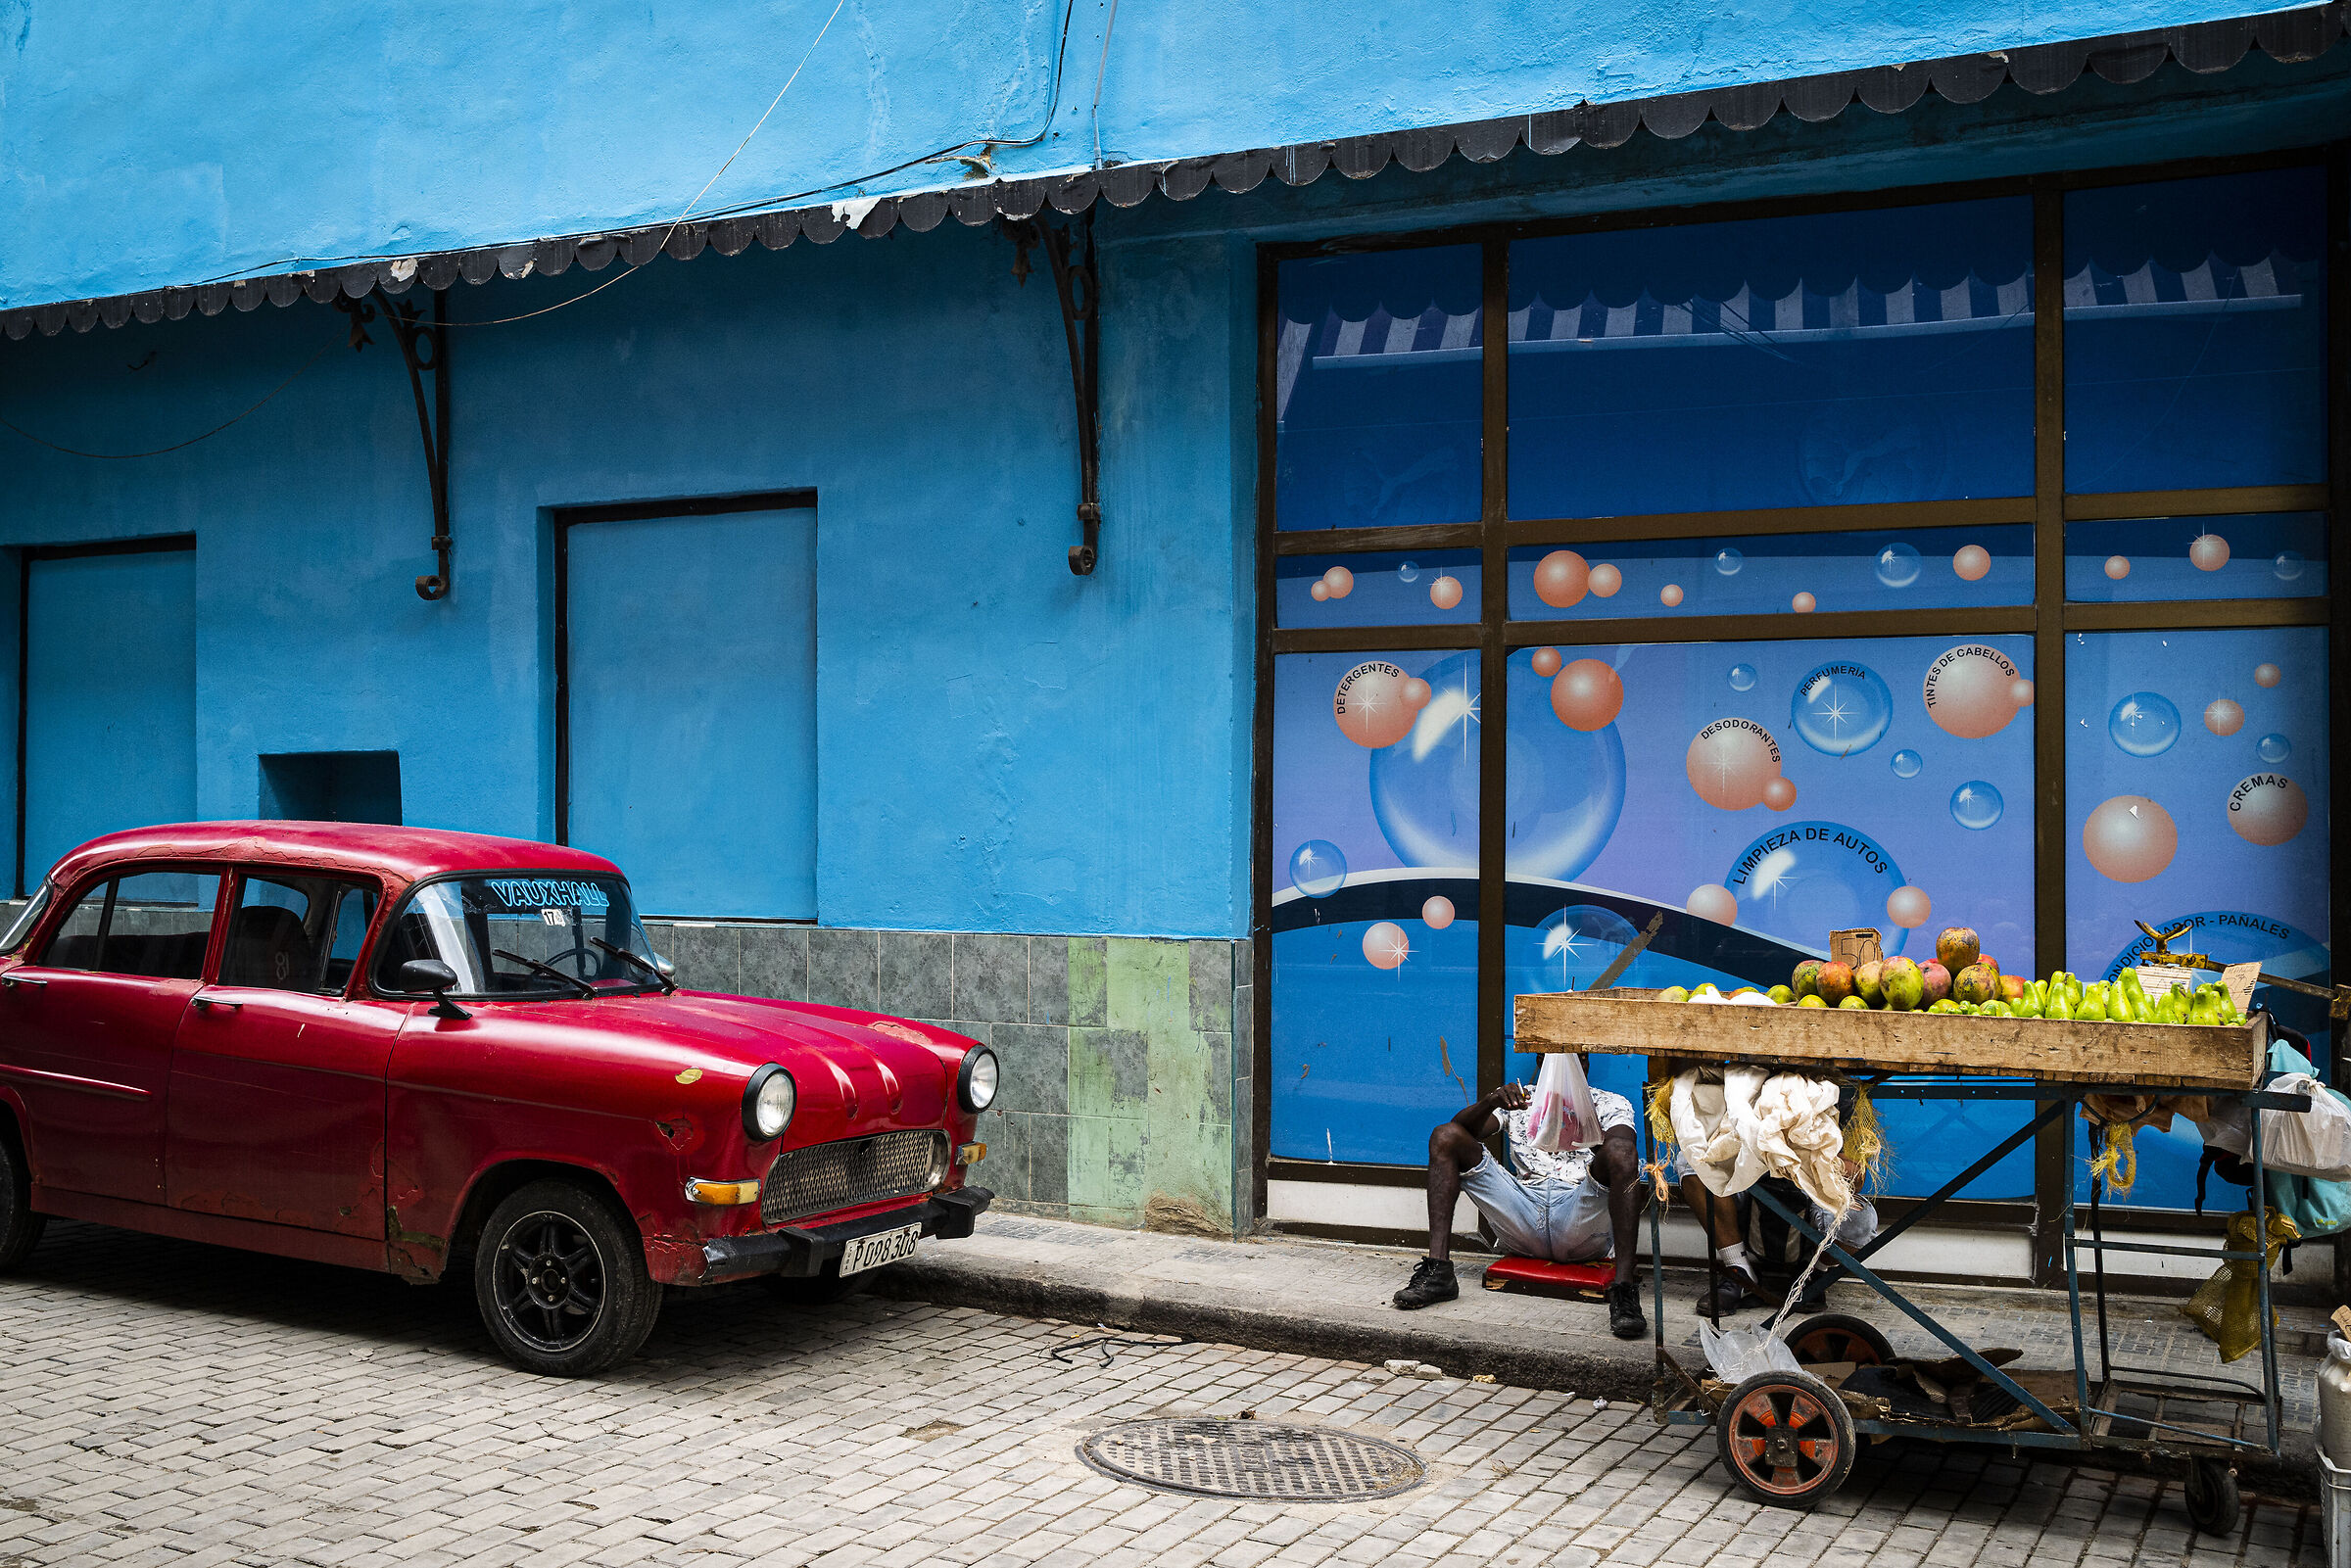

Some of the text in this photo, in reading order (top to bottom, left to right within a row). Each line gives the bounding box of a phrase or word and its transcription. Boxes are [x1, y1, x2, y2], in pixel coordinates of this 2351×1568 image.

[1336, 663, 1400, 714] DETERGENTES
[1926, 647, 2015, 708] TINTES DE CABELLOS
[1701, 719, 1781, 763] DESODORANTES
[2230, 775, 2288, 812] CREMAS
[1733, 828, 1888, 884] LIMPIEZA DE AUTOS
[491, 880, 610, 907] VAUXHALL
[2219, 913, 2290, 939] PAÑALES
[1841, 937, 1876, 971] 50
